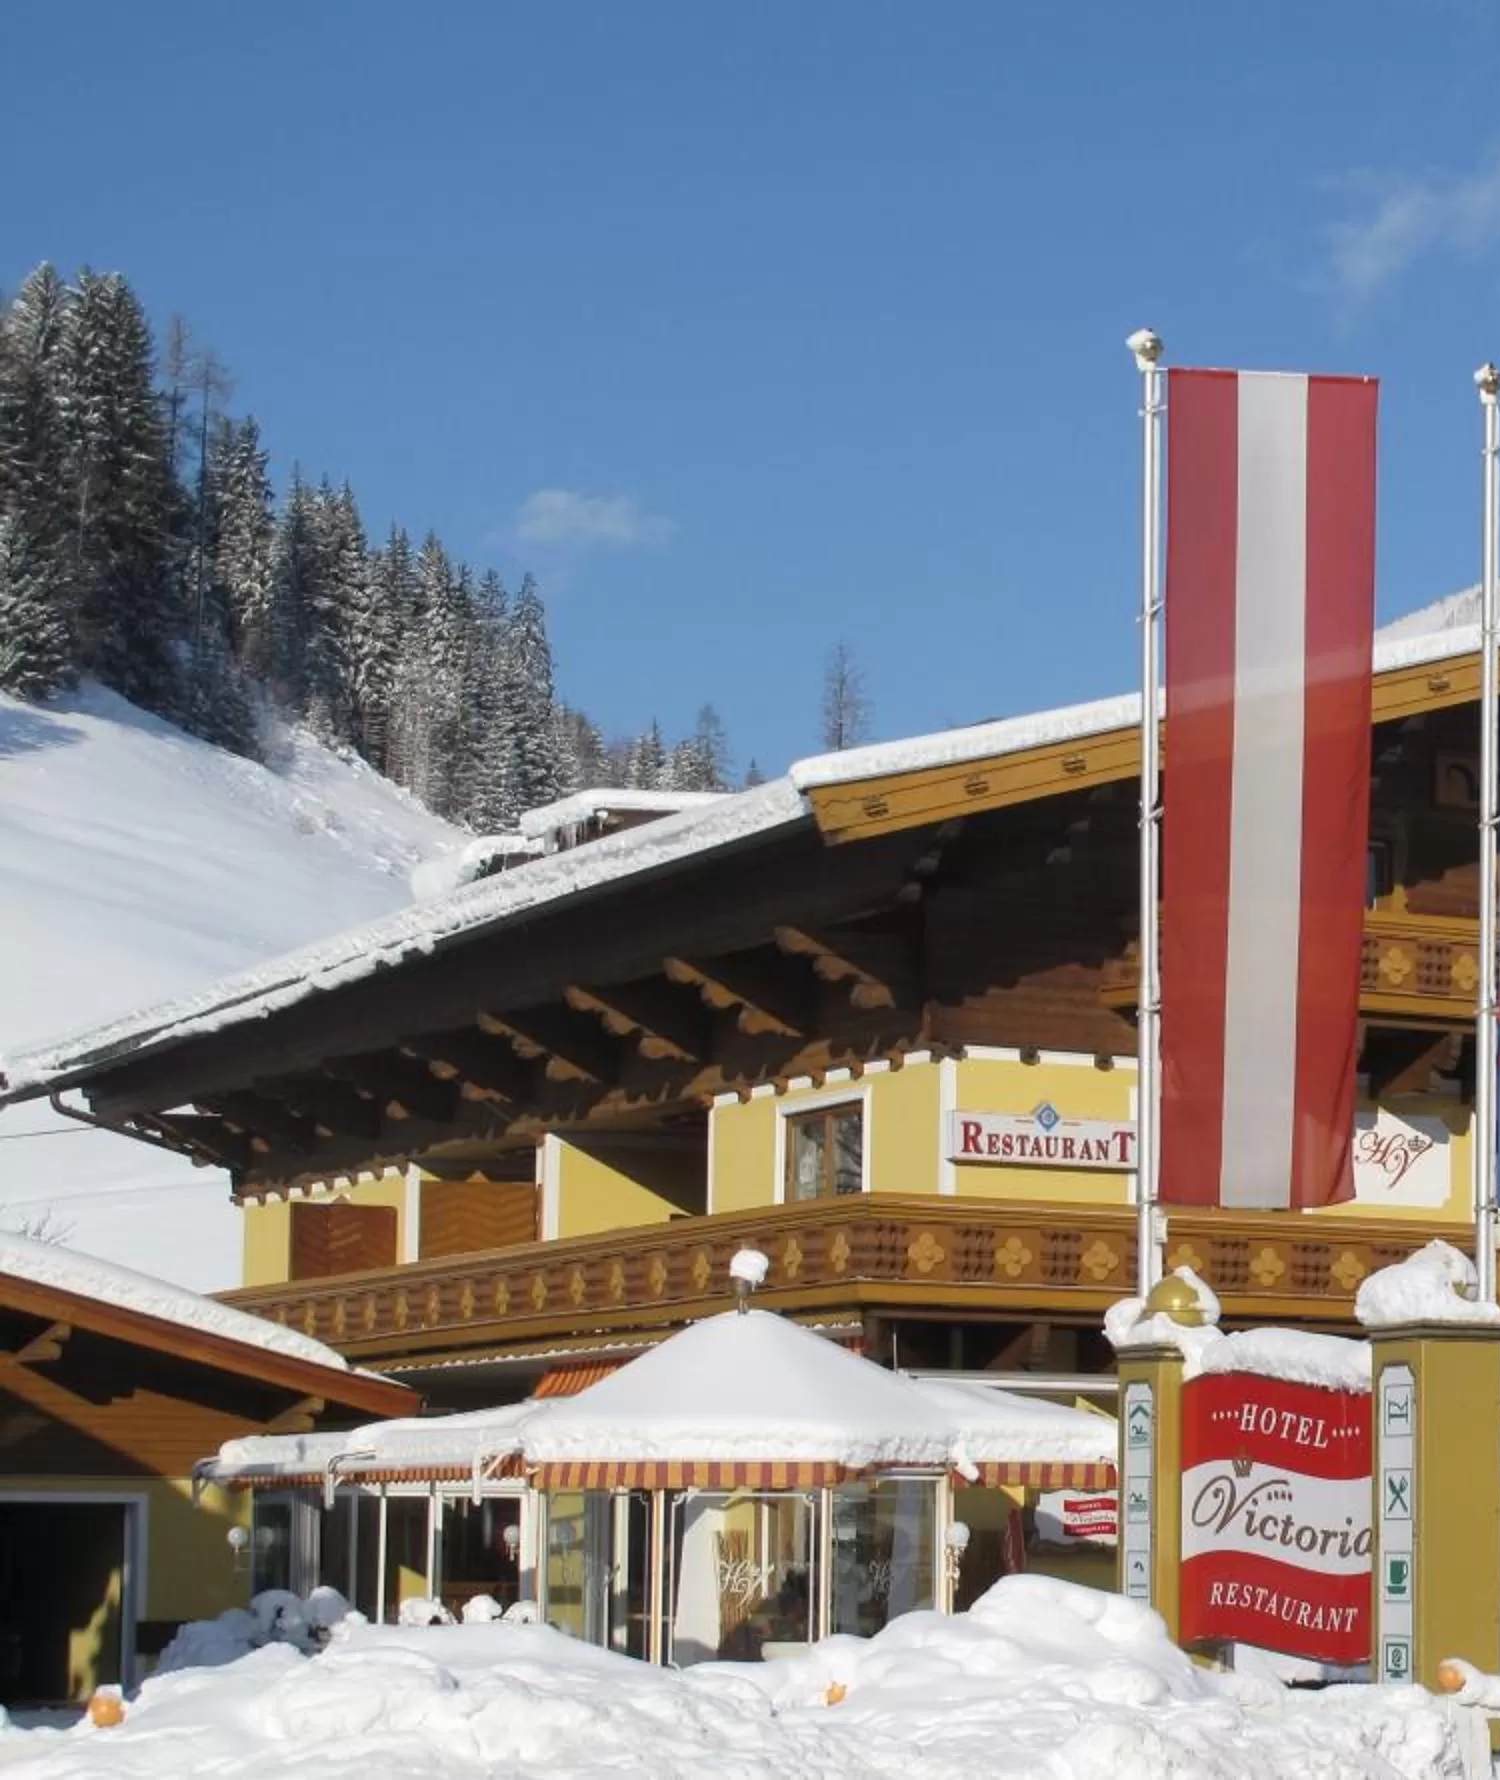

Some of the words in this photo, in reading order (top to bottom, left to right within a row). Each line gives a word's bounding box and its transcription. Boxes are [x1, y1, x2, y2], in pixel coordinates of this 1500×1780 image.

[961, 1120, 1136, 1162] RESTAURANT
[1240, 1403, 1329, 1448] HOTEL
[1192, 1475, 1373, 1557] Victoria
[1210, 1581, 1358, 1632] RESTAURANT
